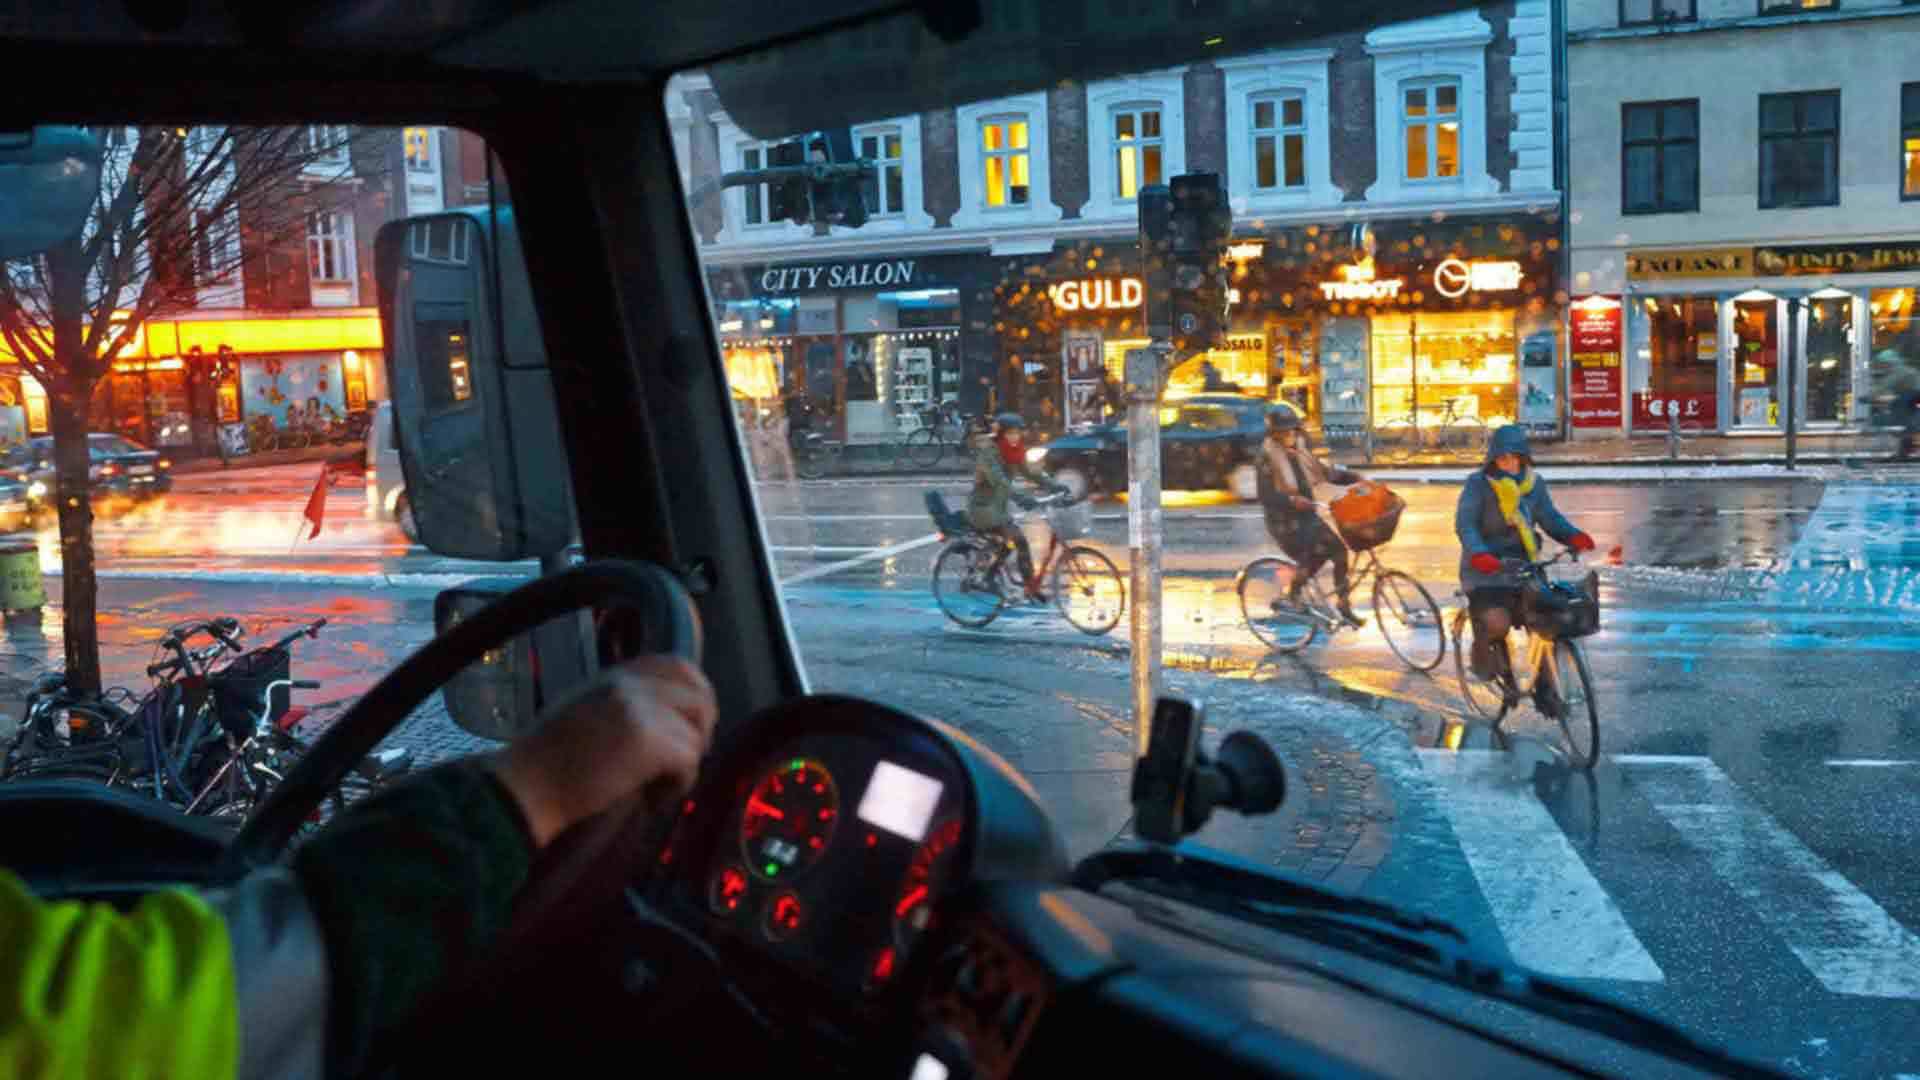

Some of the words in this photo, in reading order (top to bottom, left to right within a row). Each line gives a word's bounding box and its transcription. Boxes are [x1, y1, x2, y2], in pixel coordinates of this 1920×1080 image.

[761, 267, 823, 291] CITY
[827, 261, 915, 288] SALON
[1055, 278, 1143, 311] GULD
